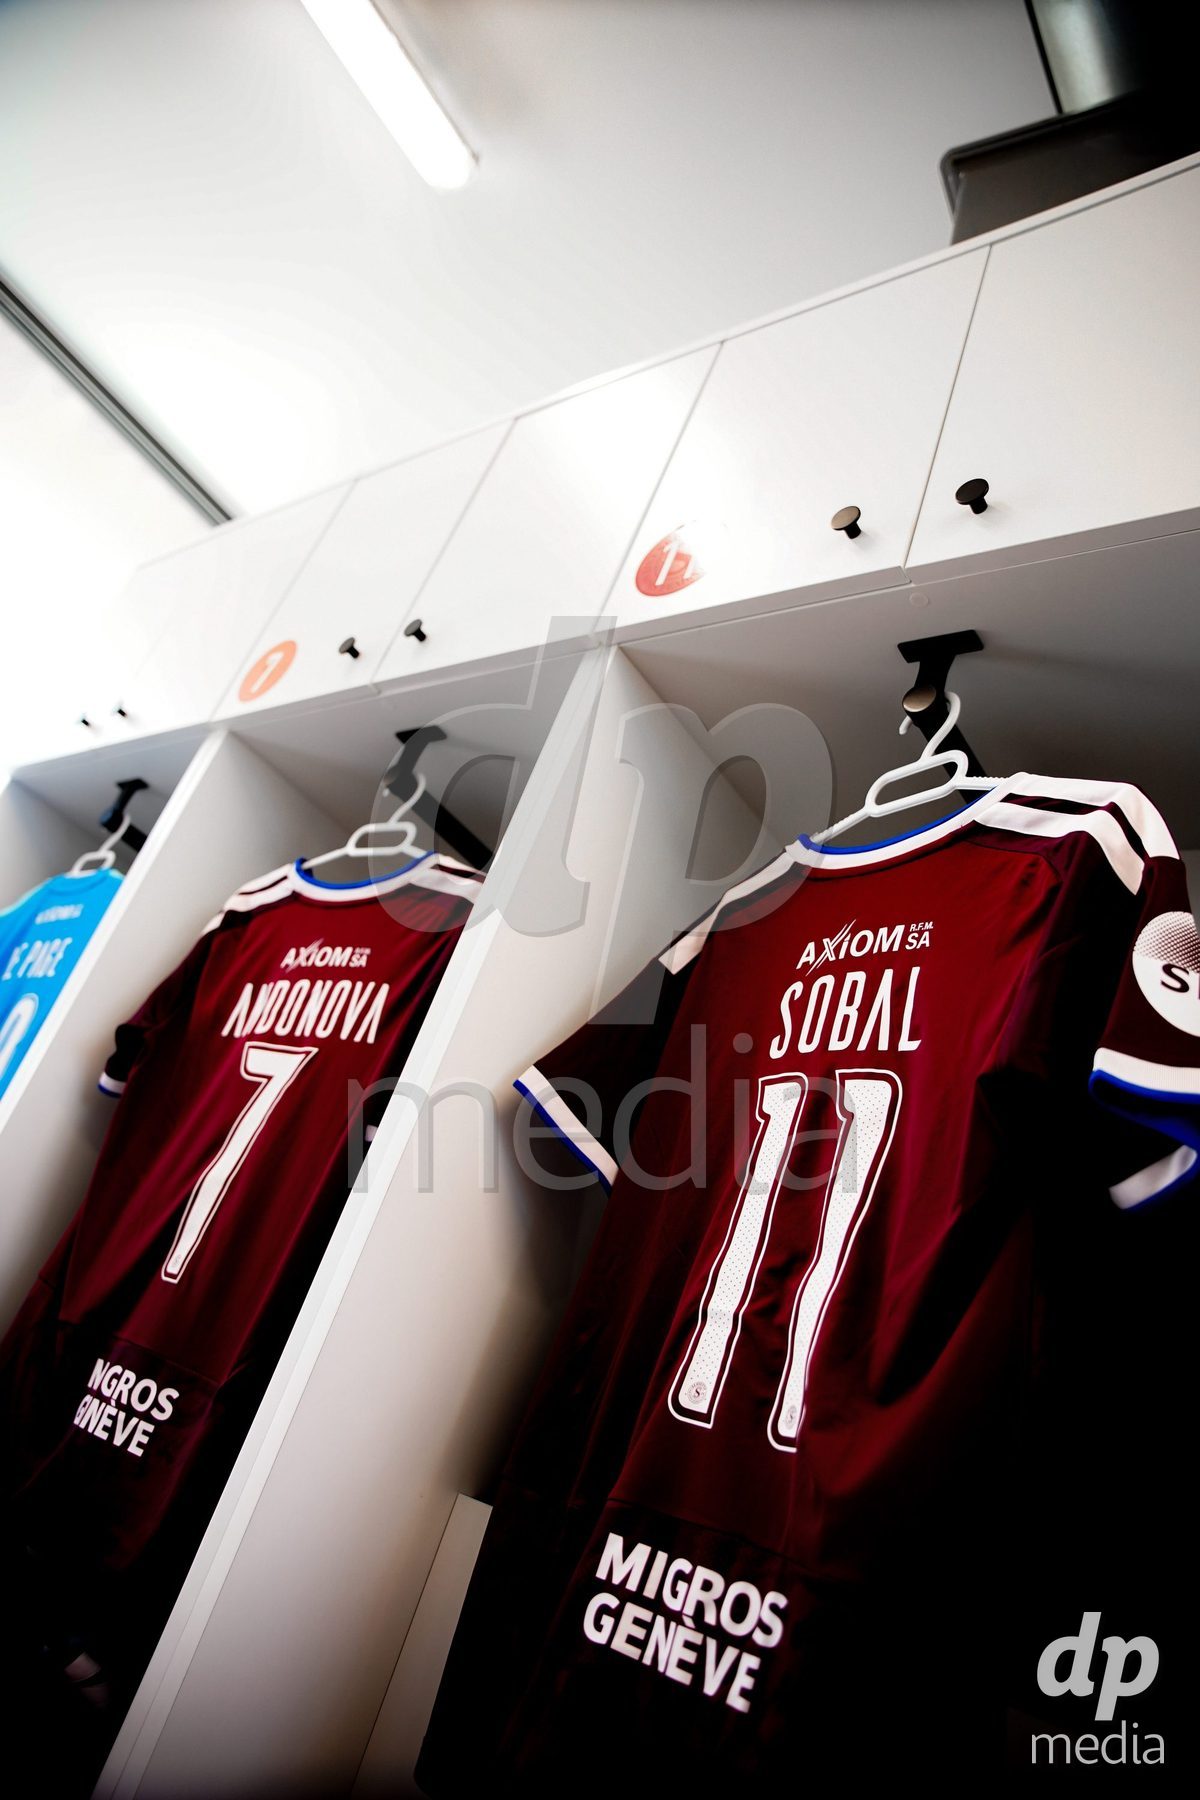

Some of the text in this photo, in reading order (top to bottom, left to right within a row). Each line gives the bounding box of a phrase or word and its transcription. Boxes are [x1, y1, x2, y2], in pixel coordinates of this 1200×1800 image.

[905, 931, 931, 950] SA
[221, 979, 390, 1044] ANDONOVA
[769, 966, 922, 1059] SOBAL
[161, 1041, 320, 1285] 7
[667, 1068, 903, 1453] 11
[595, 1532, 788, 1648] MIGROS
[583, 1592, 761, 1713] GENÈVE
